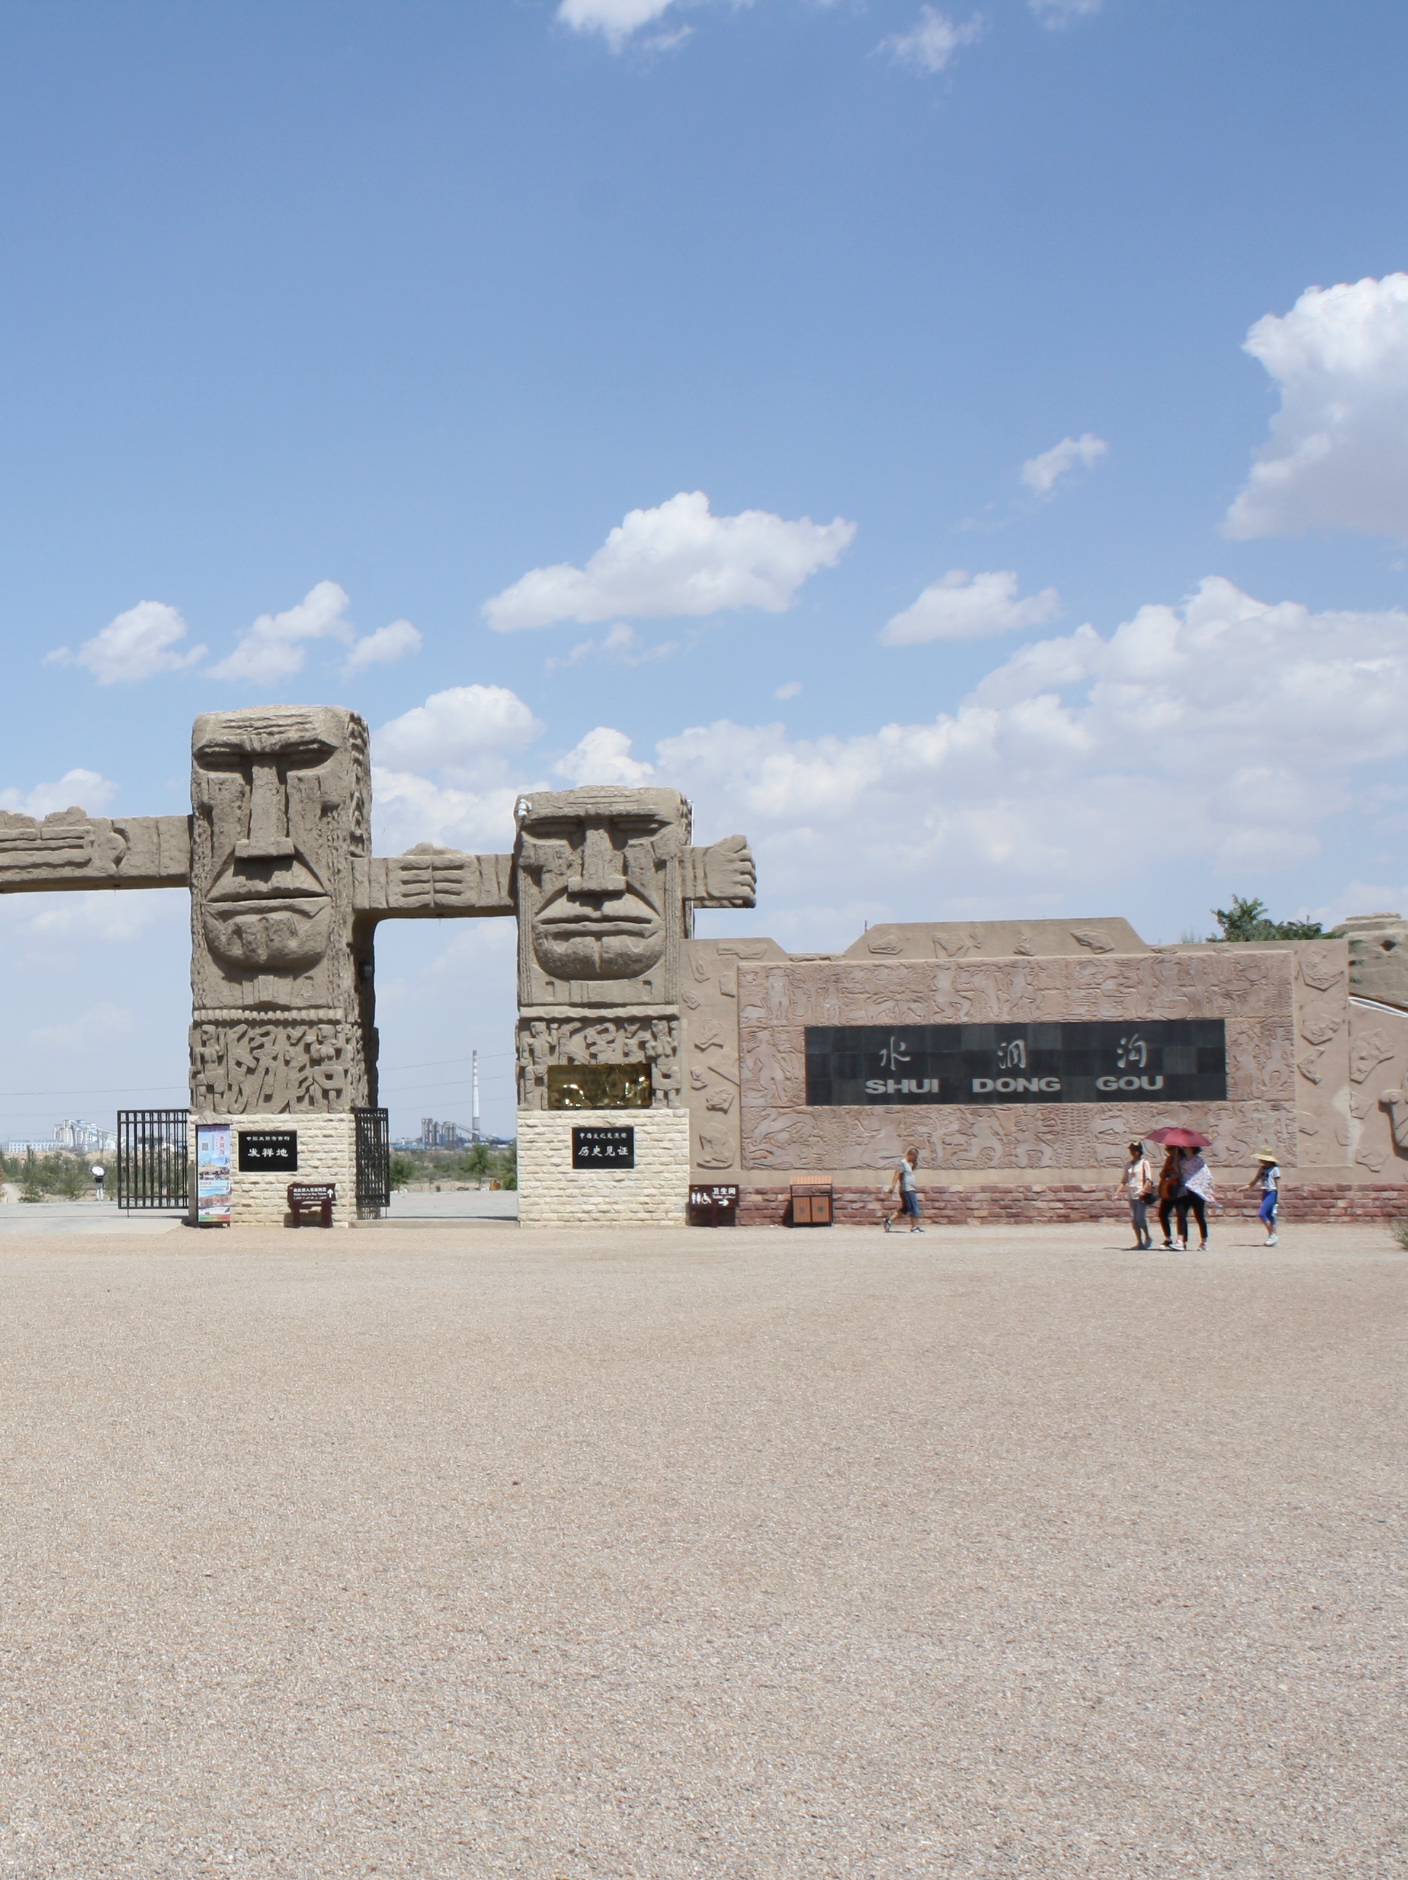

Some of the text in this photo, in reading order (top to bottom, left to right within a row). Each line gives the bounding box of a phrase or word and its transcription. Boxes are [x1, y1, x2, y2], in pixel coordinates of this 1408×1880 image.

[864, 1075, 1165, 1095] SHUI DONG GOU
[247, 1147, 289, 1158] 发祥地
[577, 1144, 629, 1158] 历史见证
[711, 1186, 736, 1195] 卫生间
